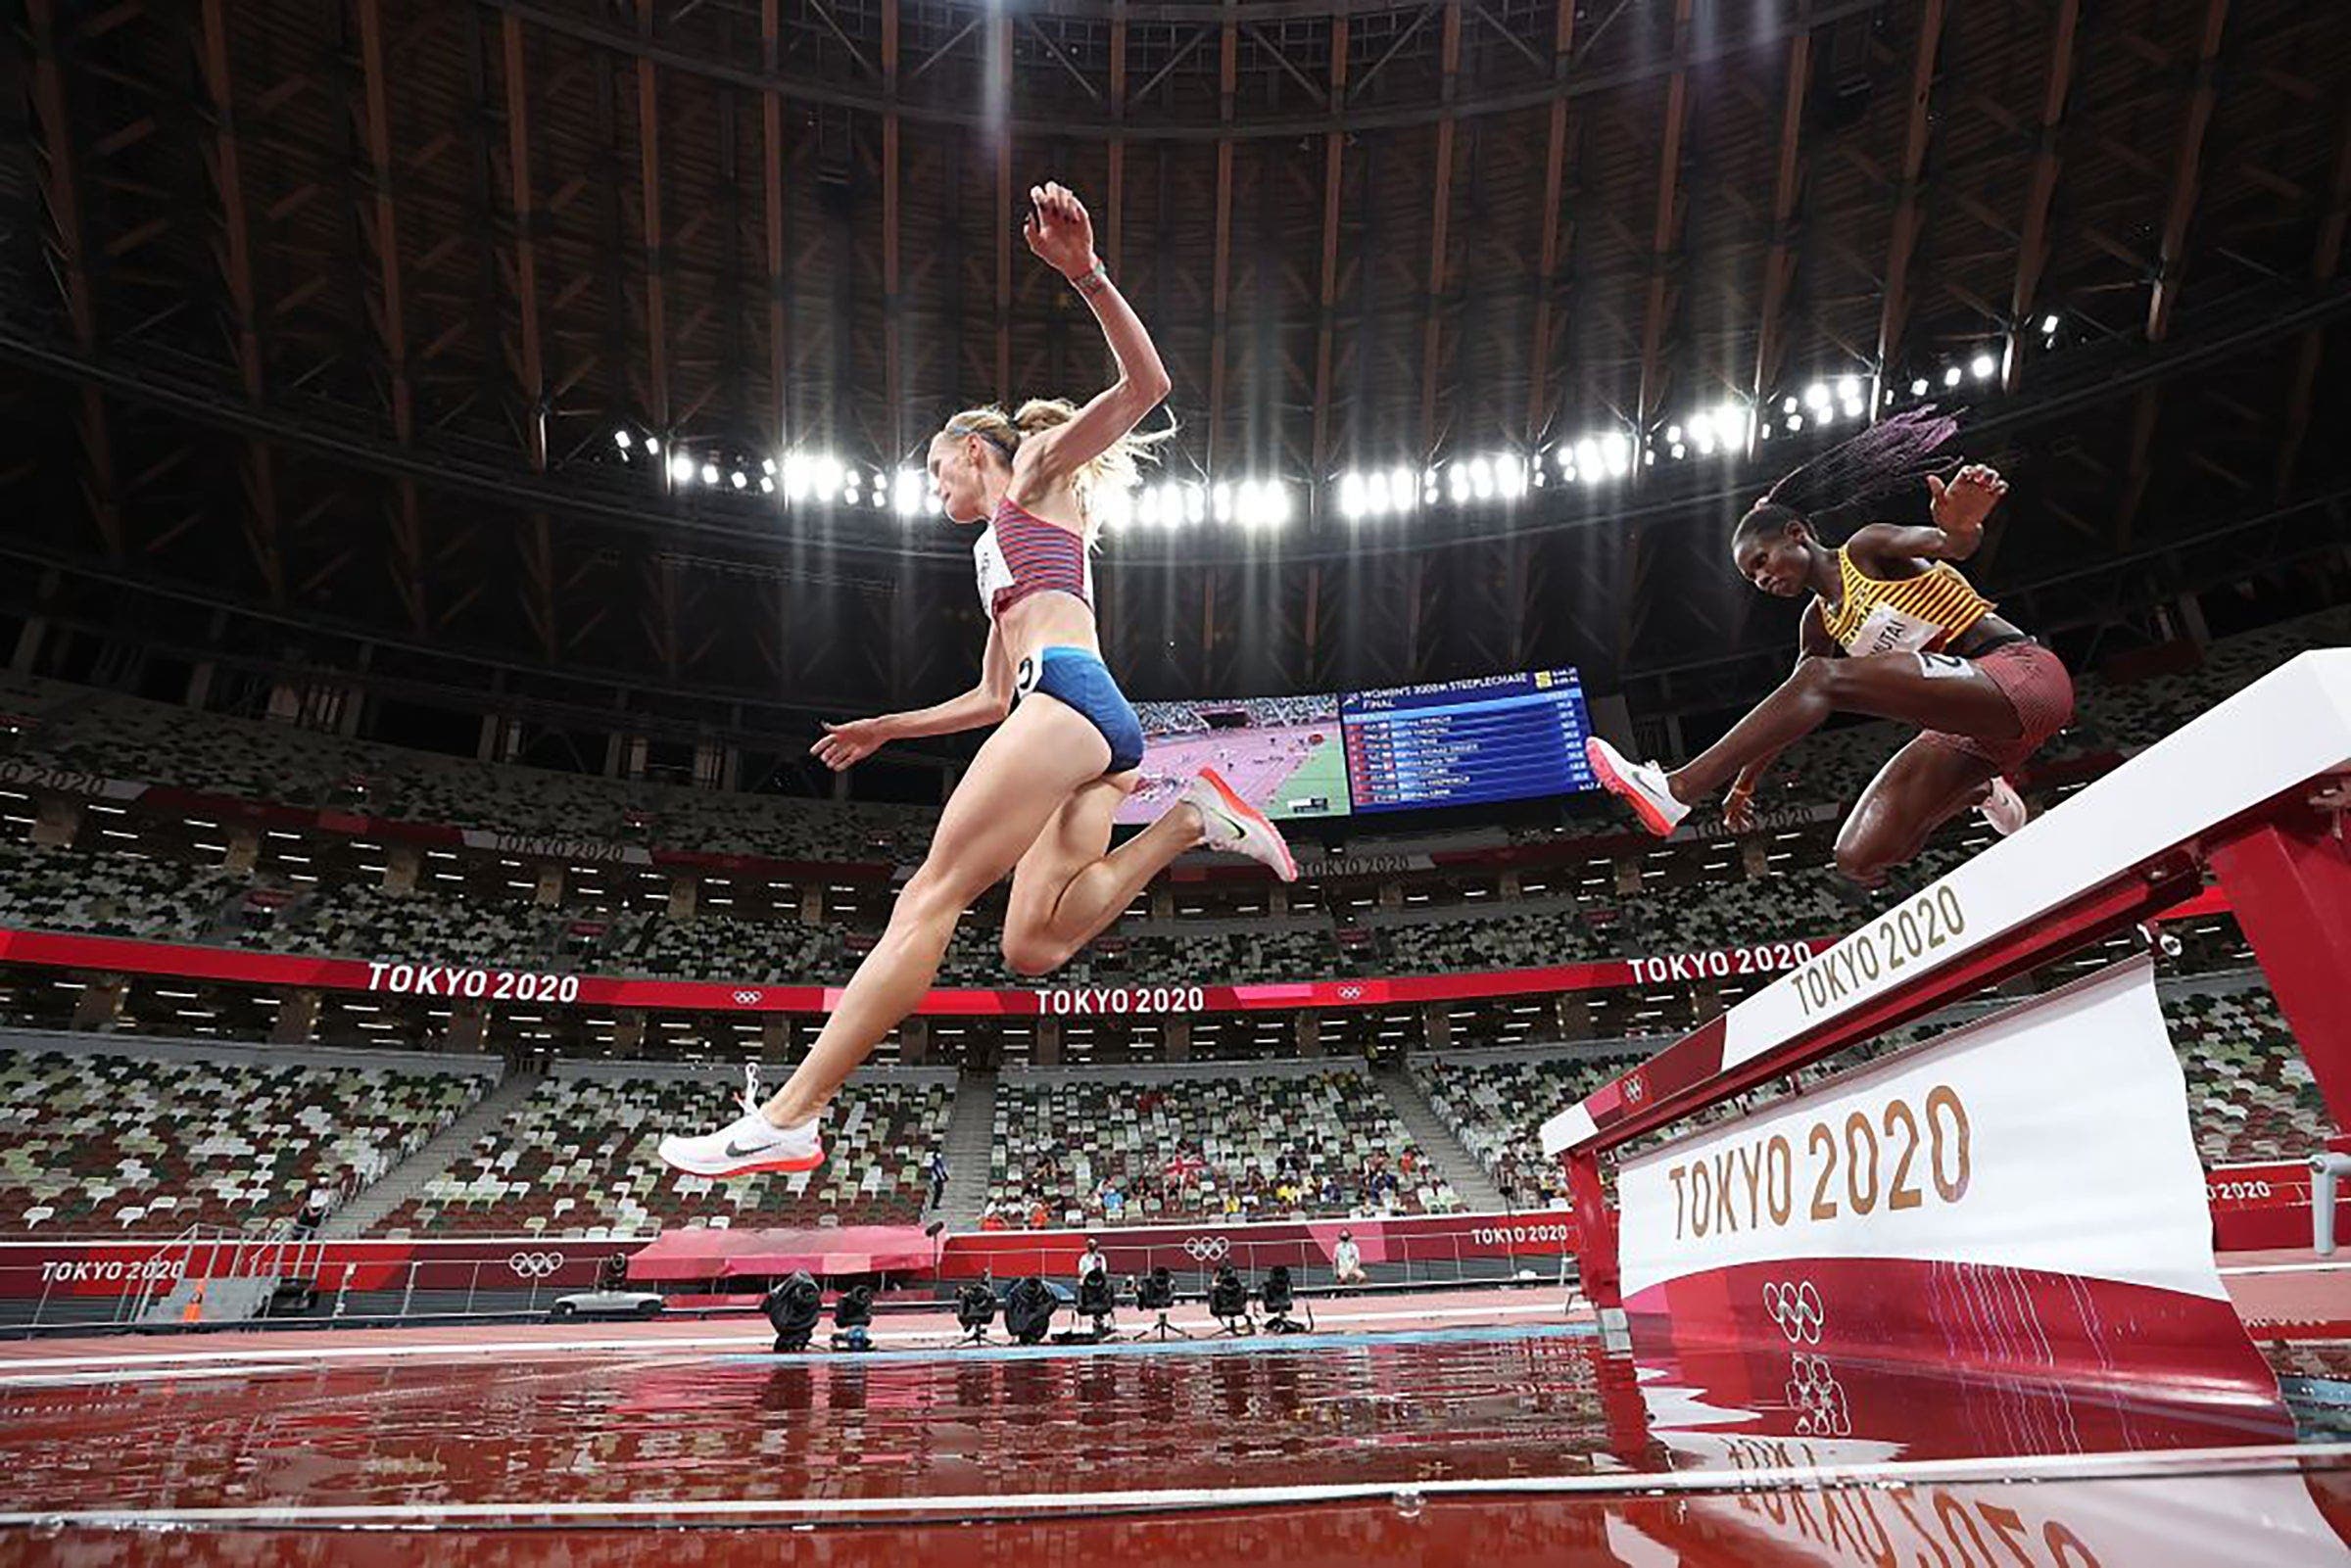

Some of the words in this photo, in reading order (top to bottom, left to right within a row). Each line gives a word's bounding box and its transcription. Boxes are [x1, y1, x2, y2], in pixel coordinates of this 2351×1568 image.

[1868, 619, 1905, 656] MUTAI
[1450, 672, 1527, 691] STEEPLECHASE
[1363, 698, 1396, 709] FINAL
[496, 834, 565, 858] TOKYO
[1627, 952, 1728, 984] TOKYO
[1738, 940, 1811, 975] 2020
[1792, 935, 1879, 1016] TOKYO
[1880, 884, 1966, 971] 2020
[368, 963, 488, 998] TOKYO
[493, 972, 579, 1003] 2020
[1034, 987, 1128, 1014] TOKYO
[1135, 986, 1204, 1013] 2020
[1669, 1134, 1791, 1240] TOKYO
[1808, 1085, 1970, 1221] 2020
[2217, 1180, 2272, 1200] 2020
[1528, 1223, 1568, 1242] 2020
[41, 1260, 122, 1282] TOKYO
[125, 1259, 184, 1280] 2020
